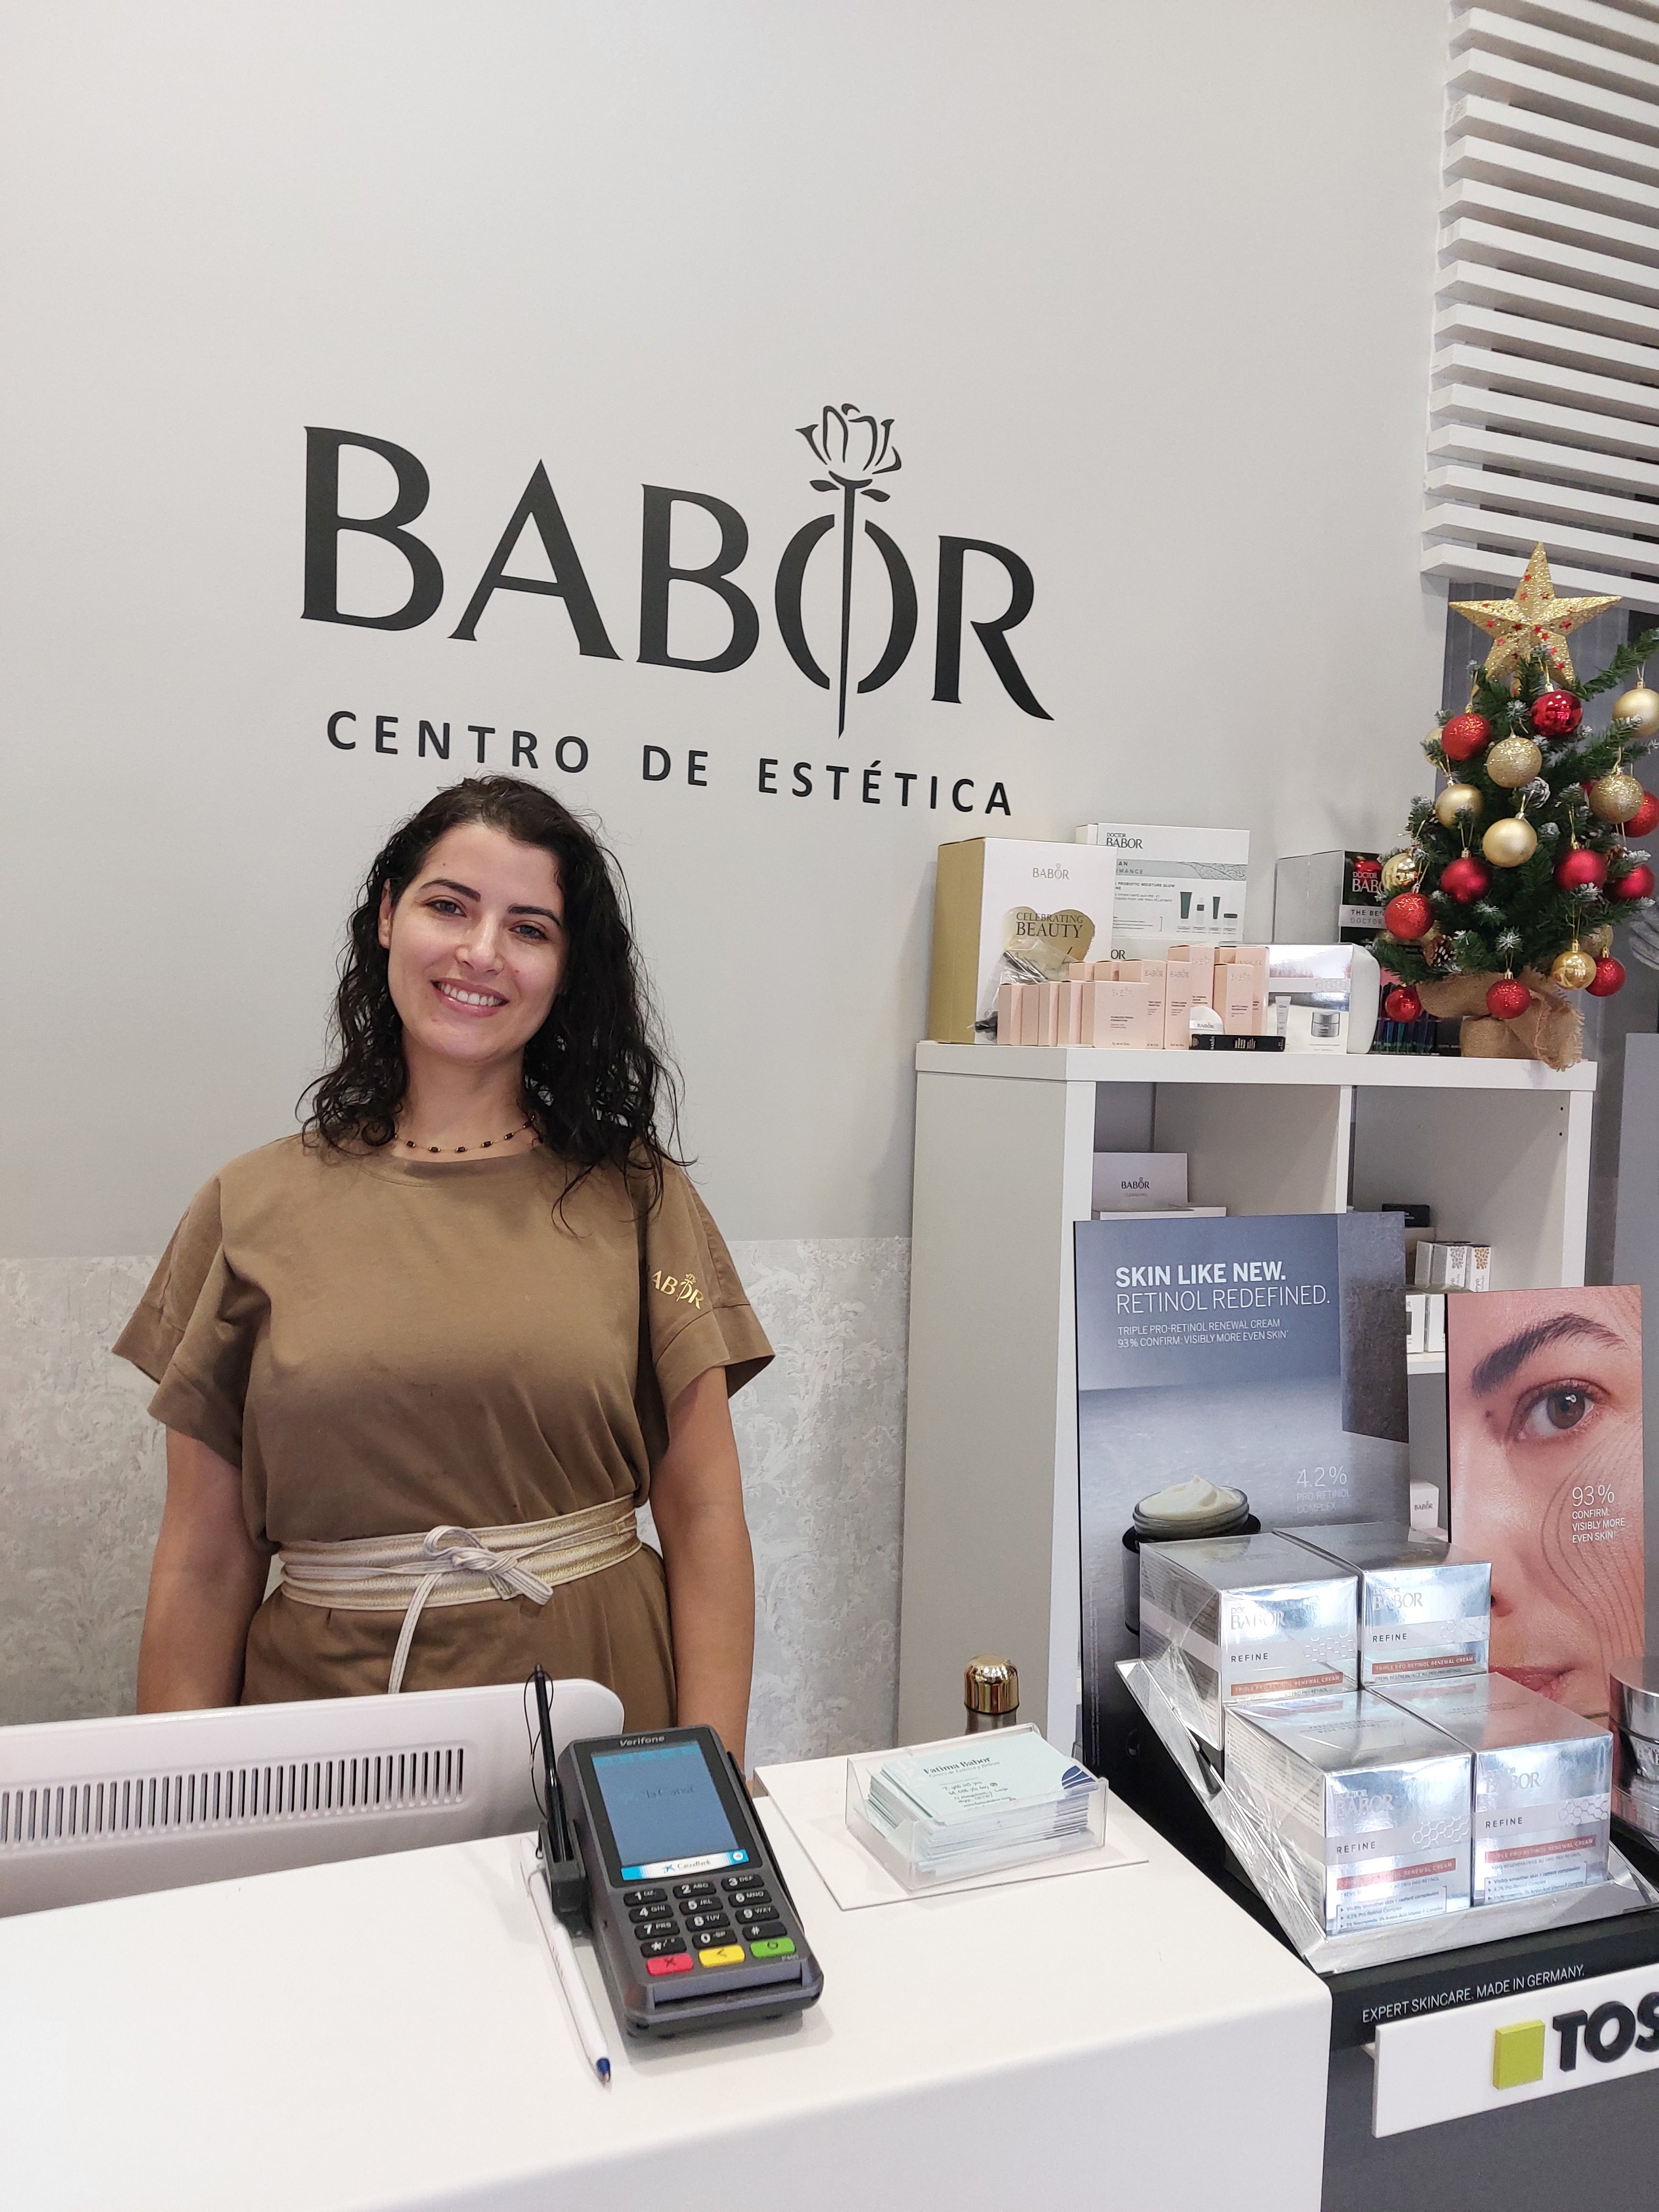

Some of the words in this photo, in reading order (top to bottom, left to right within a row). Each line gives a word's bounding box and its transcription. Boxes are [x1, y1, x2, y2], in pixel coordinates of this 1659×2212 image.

[300, 421, 1055, 732] BABOR
[326, 710, 590, 773] CENTRO
[641, 745, 708, 787] DE
[759, 759, 1012, 817] ESTÉTICA
[1106, 837, 1143, 849] BABOR
[1032, 865, 1070, 880] BABOR
[1016, 912, 1084, 924] CELEBRATING
[1349, 917, 1382, 925] DOCTOR
[1016, 921, 1083, 938] BEAUTY
[1121, 1178, 1150, 1189] BABOR
[1116, 1265, 1171, 1288] SKIN
[1178, 1263, 1227, 1285] LIKE
[1233, 1261, 1286, 1283] NEW.
[1117, 1289, 1208, 1315] RETINOL
[1213, 1284, 1330, 1310] REDEFINED.
[1117, 1326, 1149, 1336] TRIPLE
[1150, 1322, 1208, 1334] PRO-RETINOL
[1208, 1320, 1250, 1331] RENEWAL
[1250, 1318, 1281, 1328] CREAM
[1117, 1338, 1139, 1349] 93%
[1183, 1334, 1216, 1345] VISIBLY
[1216, 1332, 1242, 1343] MORE
[1243, 1330, 1265, 1341] EVEN
[1296, 1465, 1348, 1488] 4.2%
[1296, 1489, 1352, 1501] PRO-RETINOL
[1572, 1483, 1615, 1507] 93%
[1572, 1520, 1601, 1532] VISIBLY
[1603, 1517, 1626, 1528] MORE
[1572, 1532, 1593, 1544] EVEN
[1372, 1592, 1424, 1611] BABOR
[1231, 1610, 1286, 1630] BABOR
[1372, 1633, 1407, 1643] REFINE
[1231, 1653, 1269, 1663] REFINE
[1294, 1679, 1320, 1687] RENEWAL
[619, 1735, 665, 1747] Verifone
[1485, 1817, 1523, 1829] REFINE
[1336, 1841, 1376, 1854] REFINE
[1548, 1843, 1574, 1852] RENEWAL
[1574, 1838, 1594, 1847] CREAM
[1404, 1867, 1431, 1876] RENEWAL
[1432, 1862, 1453, 1871] CREAM
[728, 1877, 738, 1887] 3
[681, 1884, 691, 1894] 2
[634, 1891, 642, 1901] 1
[735, 1892, 745, 1903] 6
[687, 1900, 698, 1910] 5
[639, 1907, 649, 1917] 4
[743, 1908, 753, 1919] 9
[694, 1916, 705, 1927] 8
[705, 1913, 720, 1922] TUV
[643, 1923, 653, 1935] 7
[700, 1933, 711, 1944] 0
[1362, 2000, 1410, 2024] EXPERT
[1411, 1987, 1474, 2013] SKINCARE.
[1476, 1979, 1511, 1999] MADE
[1513, 1976, 1525, 1991] IN
[1527, 1963, 1585, 1988] GERMANY.
